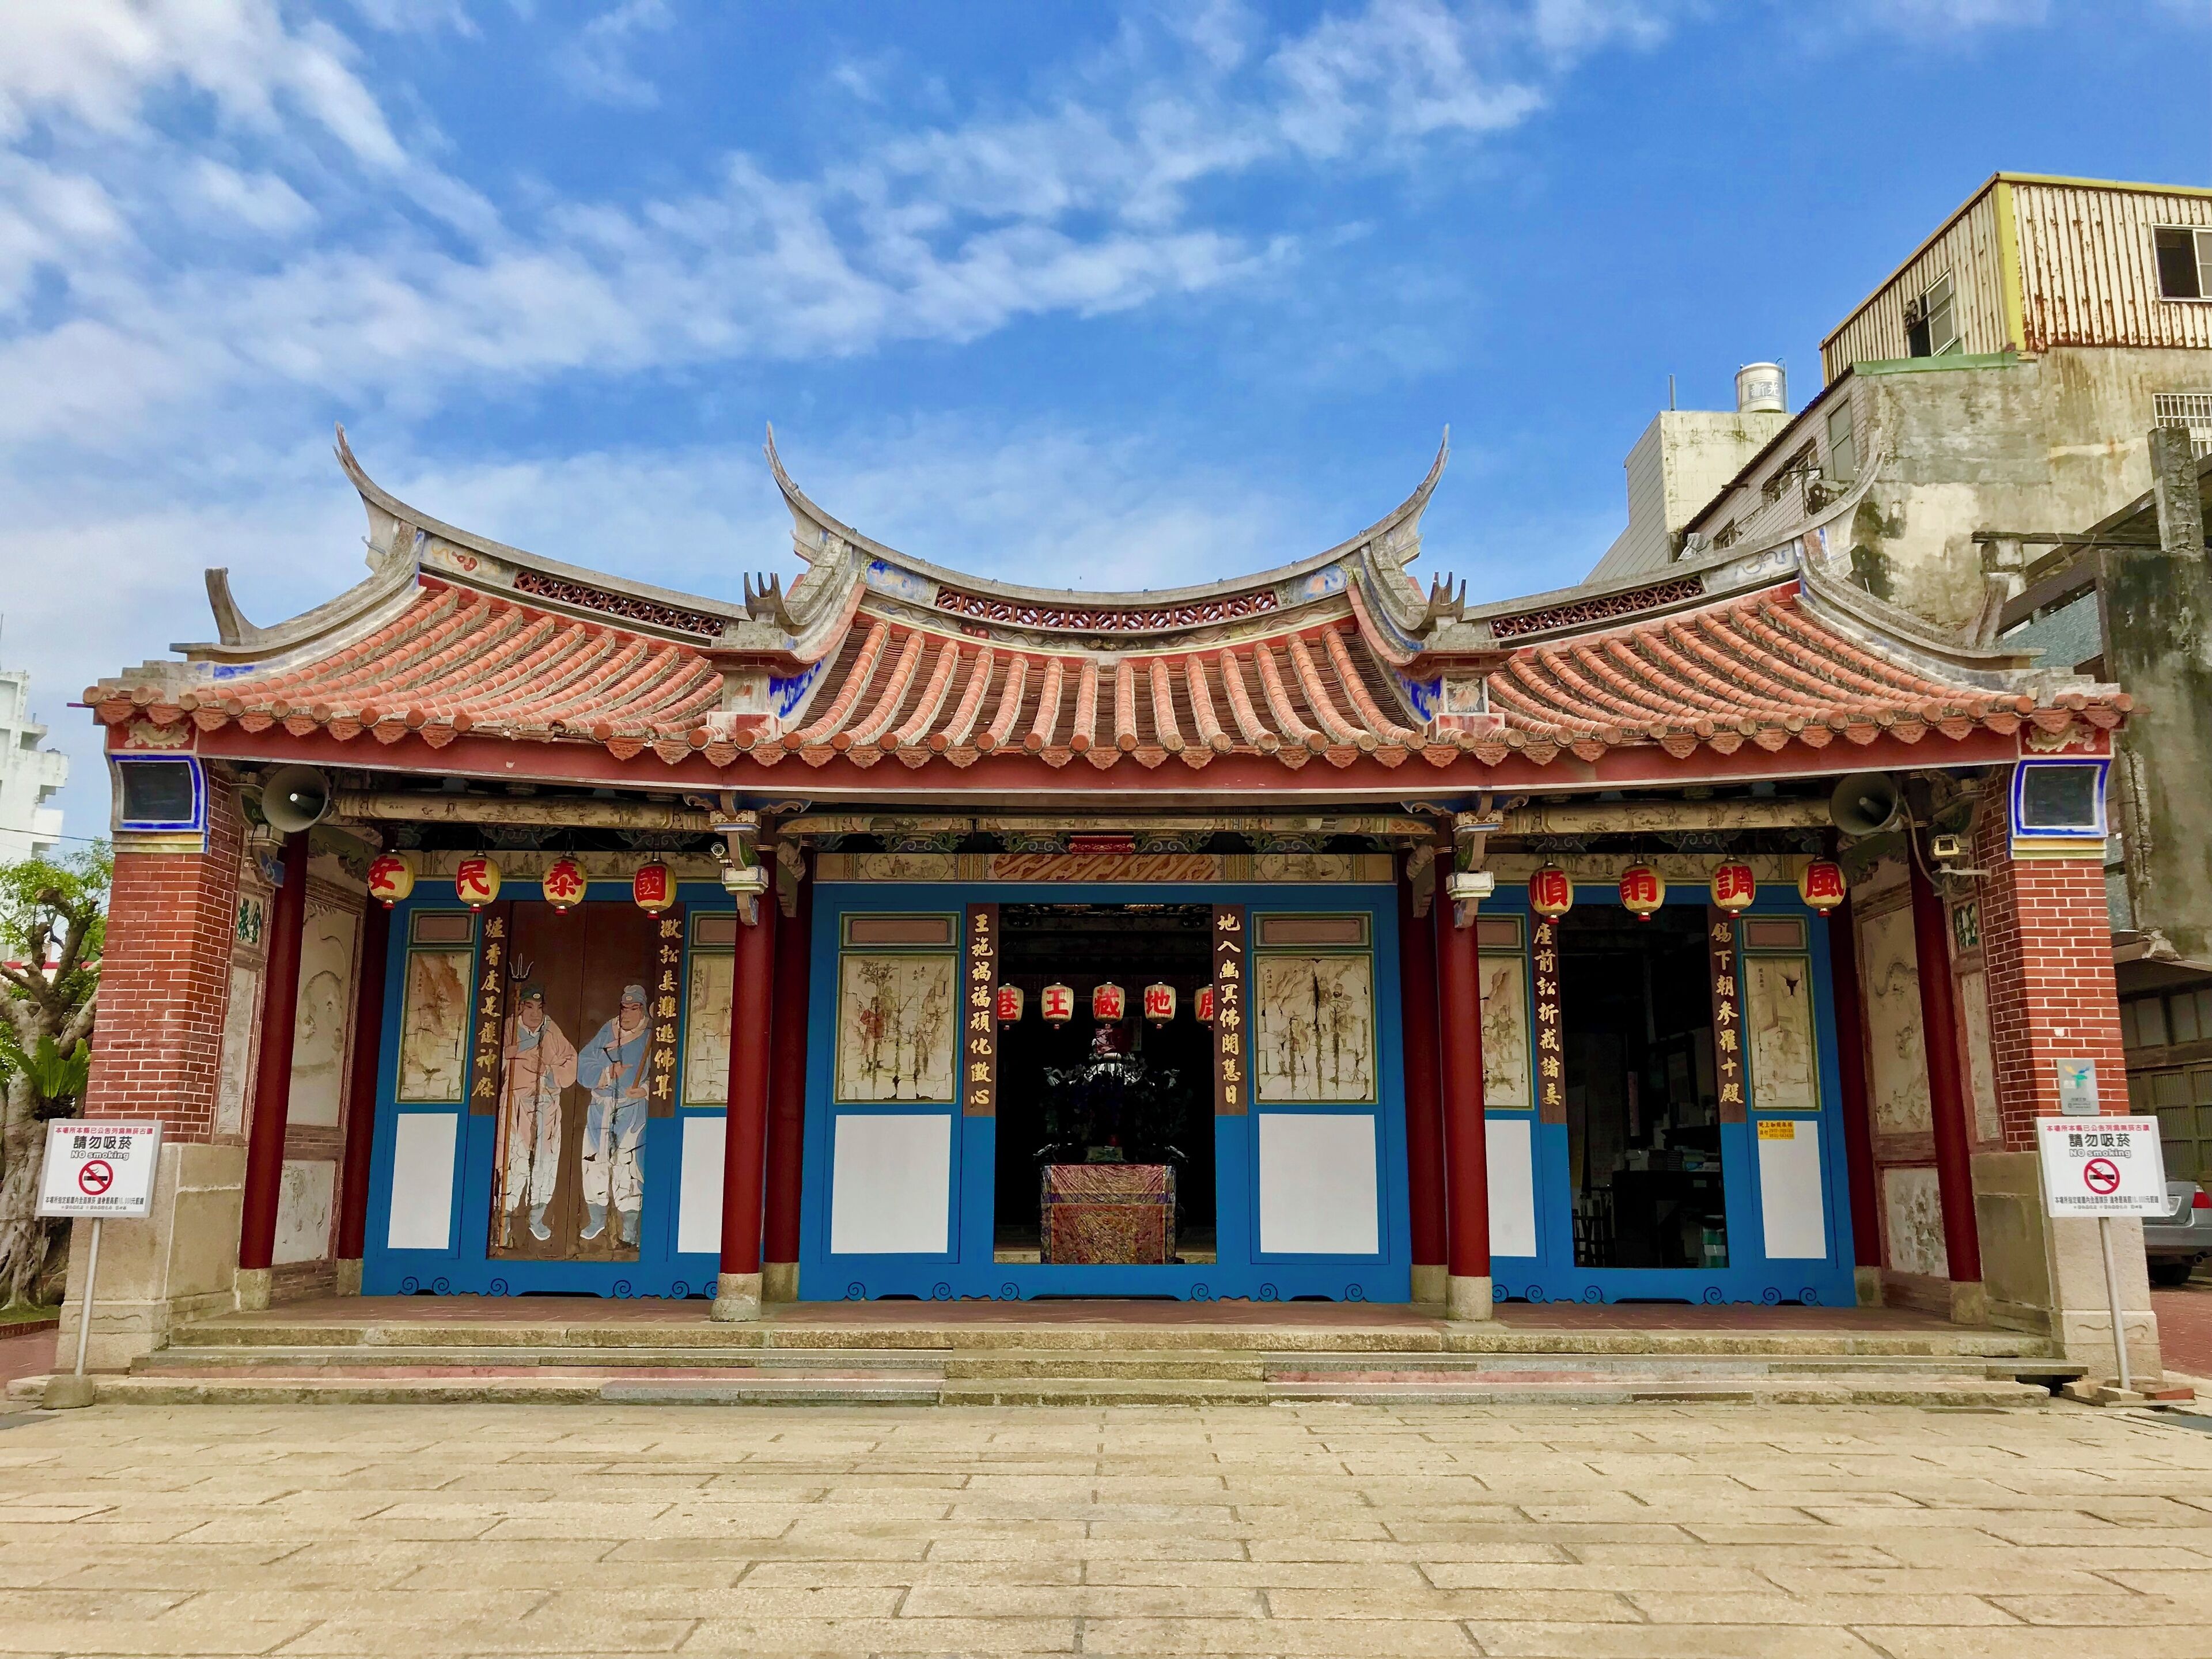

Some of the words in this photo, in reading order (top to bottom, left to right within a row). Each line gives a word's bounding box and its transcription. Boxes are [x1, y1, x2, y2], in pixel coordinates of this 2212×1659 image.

[457, 859, 490, 896] 民
[544, 859, 584, 897] 泰
[635, 865, 666, 902] 國
[1529, 870, 1568, 907] 順
[1619, 868, 1658, 904] 雨
[1717, 865, 1755, 901] 調
[1805, 863, 1845, 899] 風
[1044, 988, 1069, 1017] 王
[1094, 987, 1121, 1018] 藏
[1145, 987, 1172, 1015] 地
[70, 1150, 86, 1159] NO
[87, 1150, 130, 1161] smoking
[73, 1135, 132, 1150] 請勿吸菸
[2069, 1133, 2131, 1147] 請勿吸菸
[2069, 1149, 2085, 1157] NO
[2086, 1148, 2132, 1159] smoking
